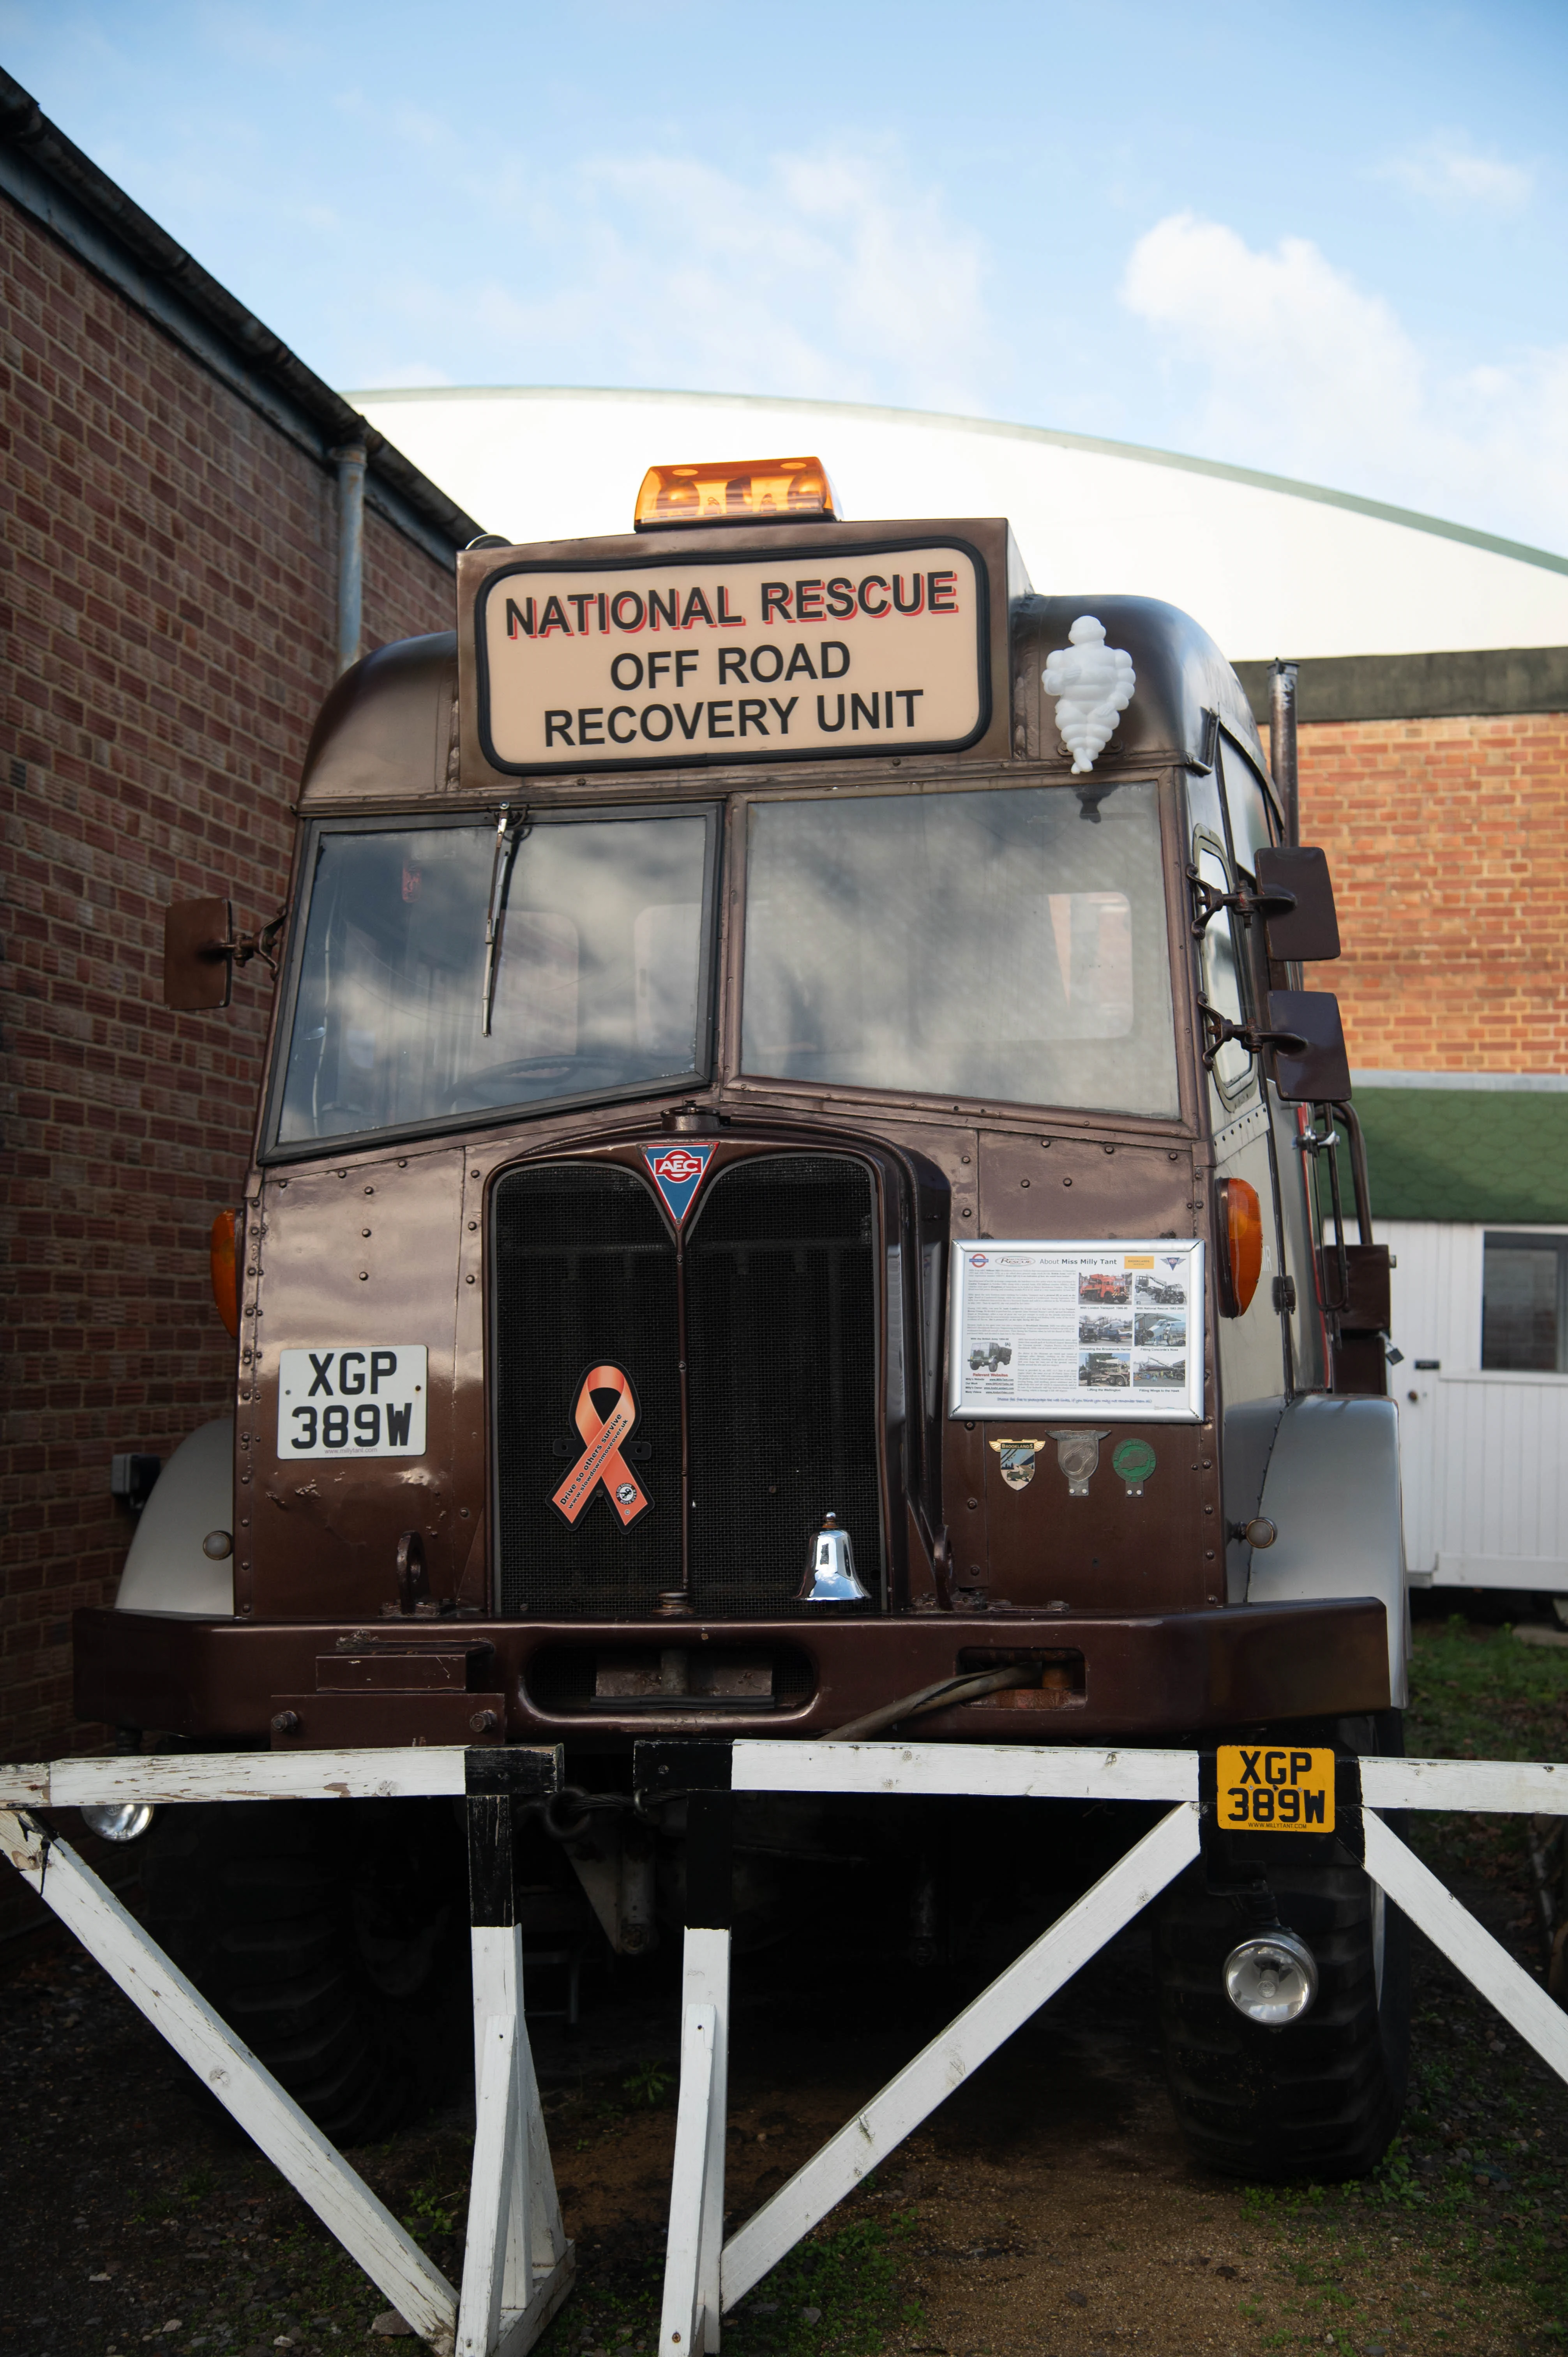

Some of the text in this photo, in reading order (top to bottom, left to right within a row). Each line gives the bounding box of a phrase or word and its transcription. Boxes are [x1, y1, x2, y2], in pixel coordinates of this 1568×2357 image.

[505, 571, 958, 639] NATIONAL RESCUE
[610, 640, 851, 691] OFF ROAD
[544, 689, 924, 747] RECOVERY UNIT
[658, 1159, 699, 1173] AEC
[307, 1351, 397, 1396] XGP
[291, 1403, 413, 1449] 389W
[560, 1413, 622, 1505] Drive so others survive
[568, 1419, 629, 1509] www.slowdownmoveover.uk
[1239, 1750, 1312, 1785] XGP
[1227, 1788, 1325, 1824] 389W
